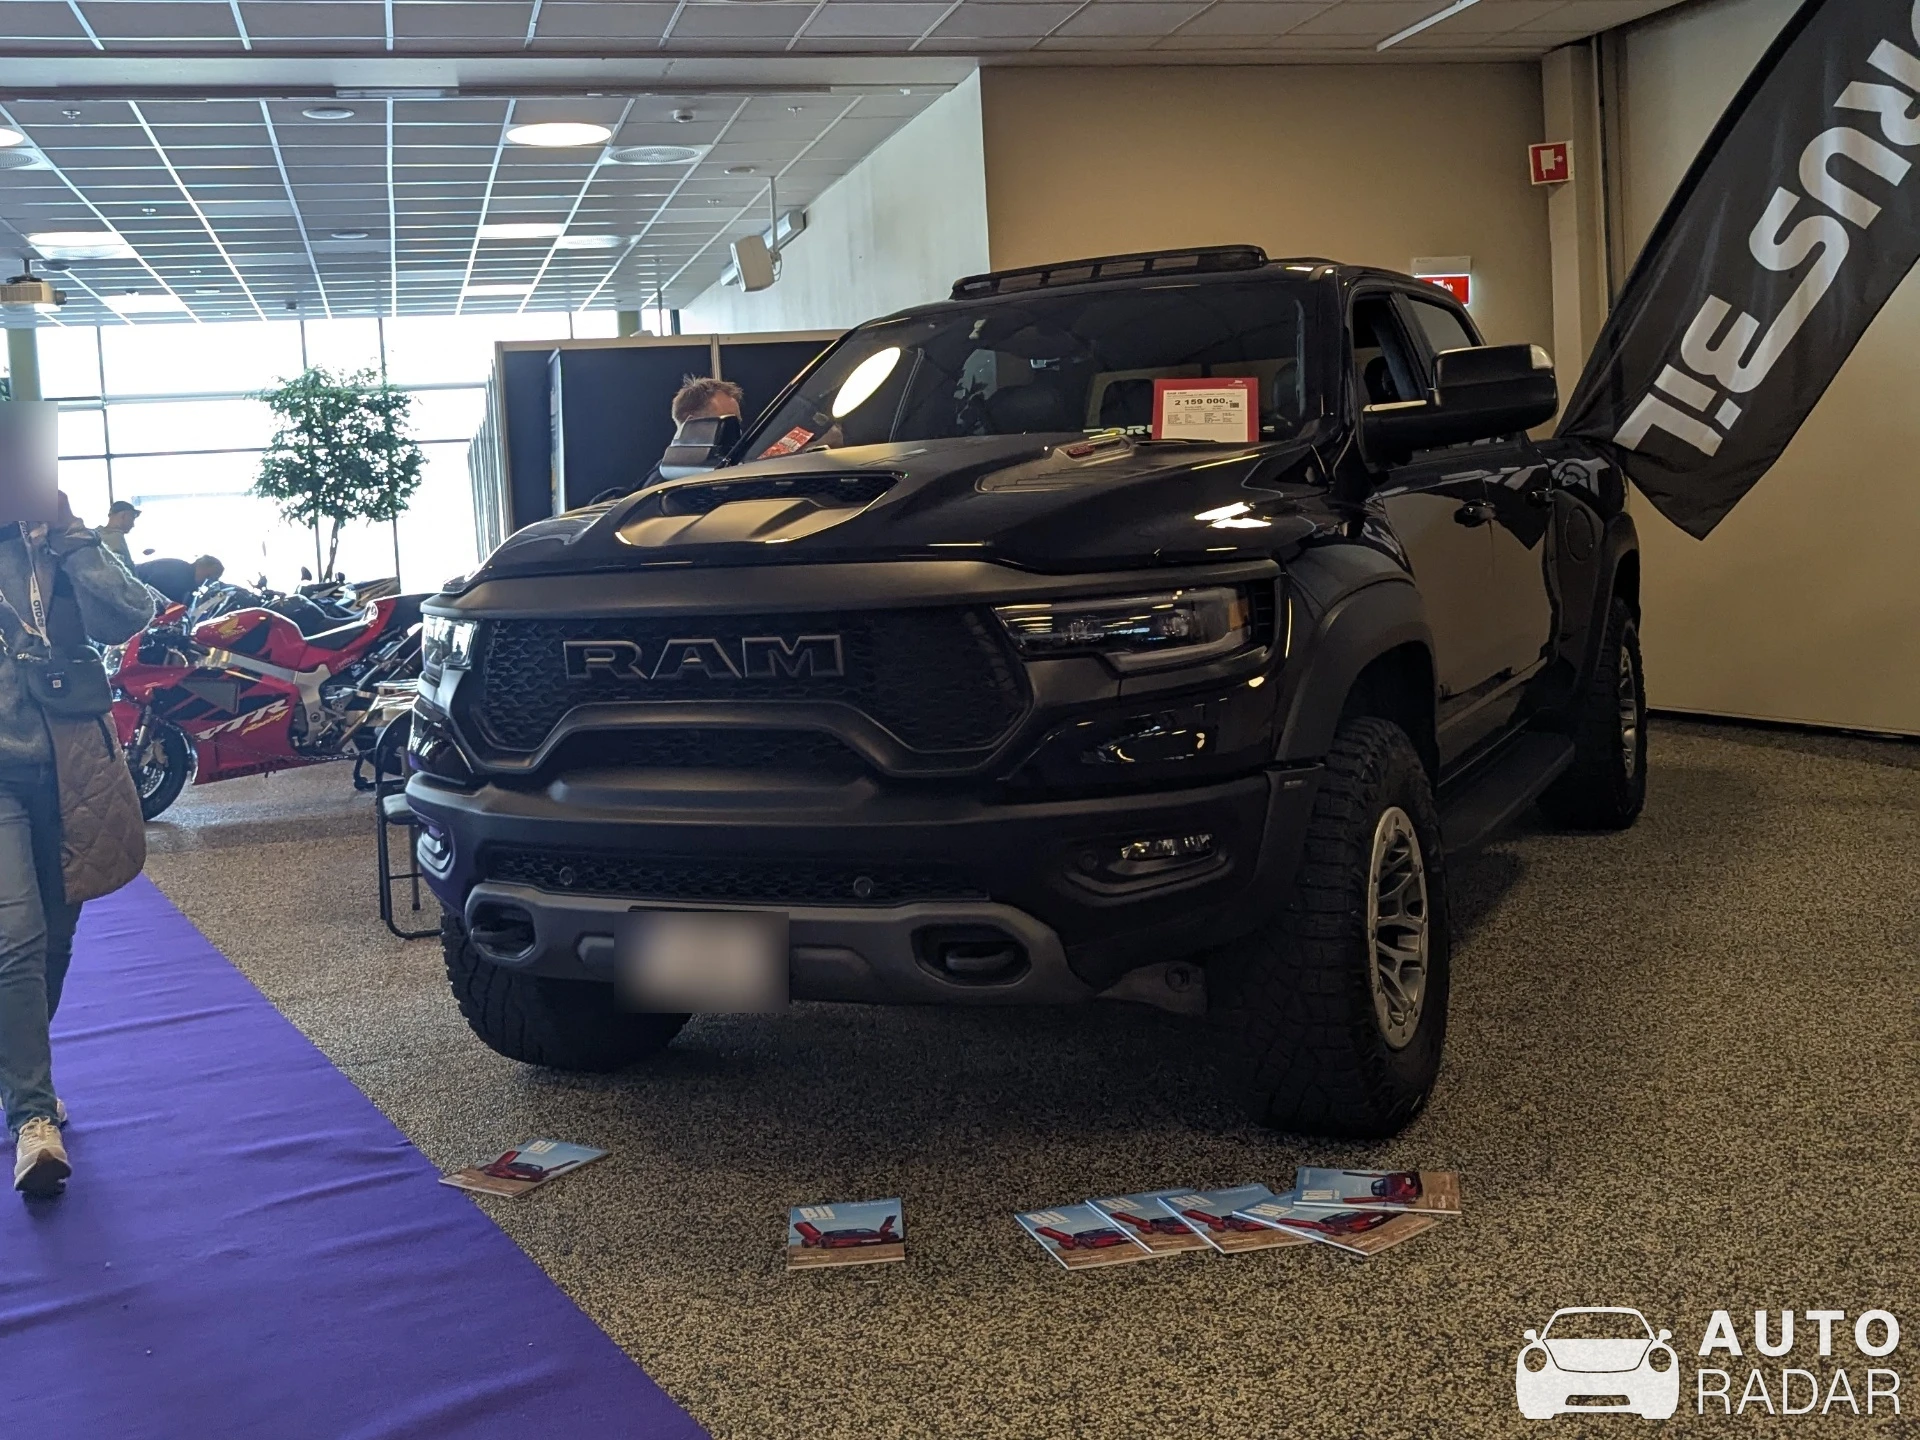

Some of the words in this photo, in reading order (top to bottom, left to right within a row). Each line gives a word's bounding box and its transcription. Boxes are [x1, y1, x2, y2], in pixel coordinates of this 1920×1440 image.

[1748, 0, 1920, 298] RUS
[563, 634, 844, 679] RAM
[194, 698, 290, 740] VTR
